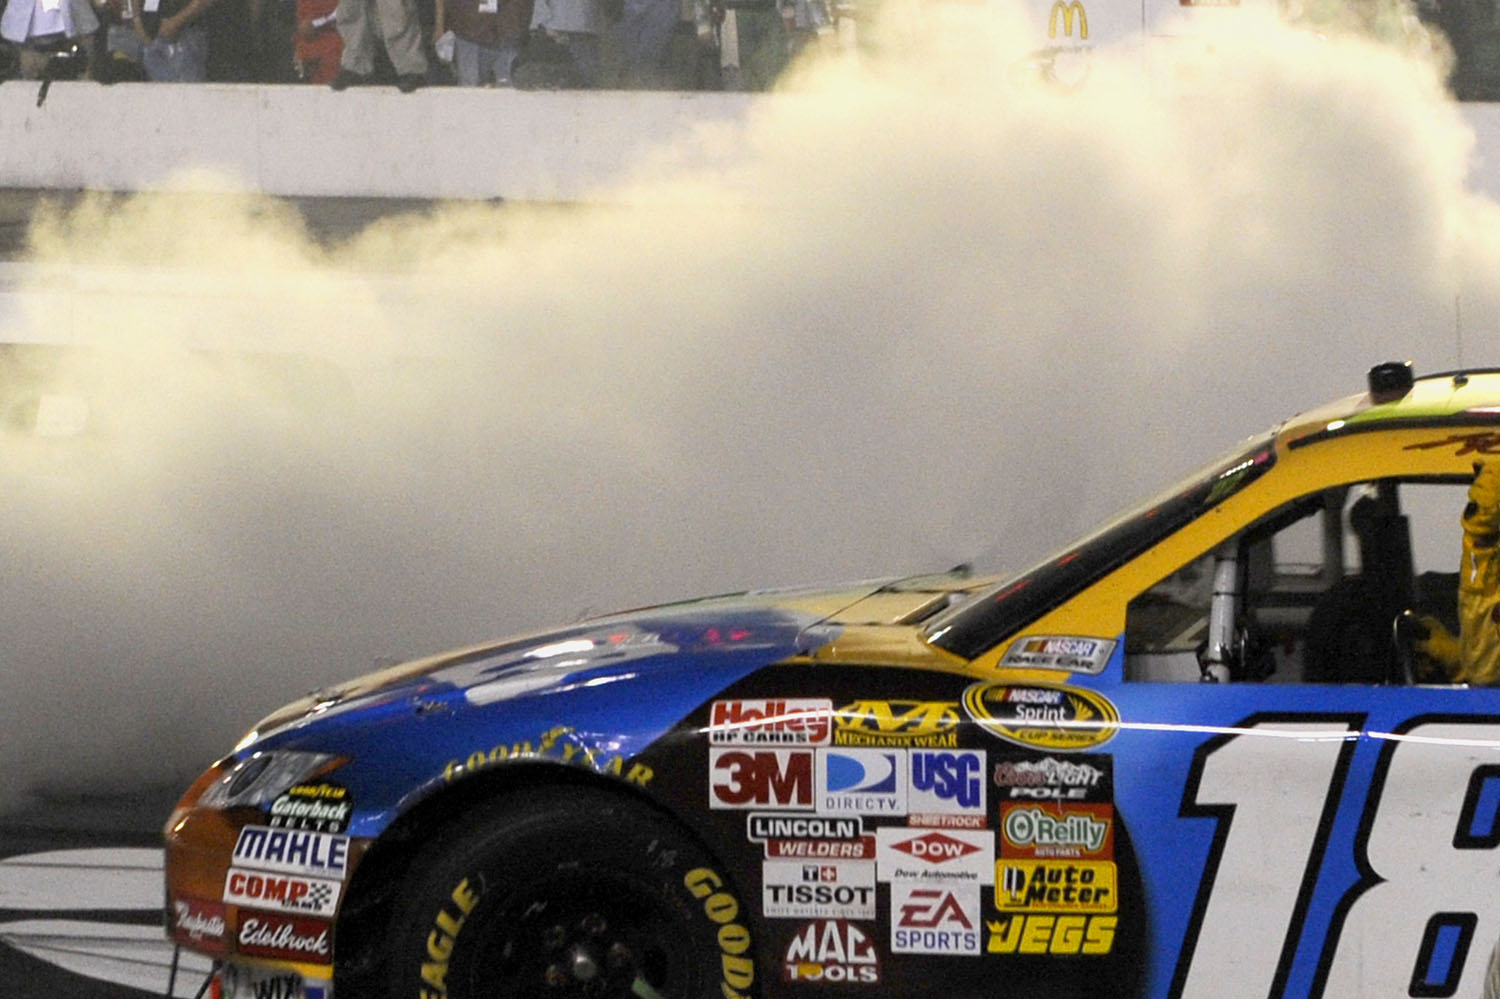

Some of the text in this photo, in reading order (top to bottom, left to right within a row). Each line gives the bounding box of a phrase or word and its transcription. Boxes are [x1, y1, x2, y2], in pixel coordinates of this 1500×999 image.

[1042, 641, 1090, 656] NASCAR
[1008, 688, 1060, 703] NASCAR
[713, 701, 829, 742] Holley
[1015, 704, 1067, 723] Sprint
[835, 730, 957, 747] MECHANIX WEAR
[713, 751, 812, 805] 3M
[912, 752, 980, 808] USG
[826, 798, 897, 810] DIRECTV
[1010, 787, 1087, 799] POLE
[270, 795, 349, 820] Gatorback
[756, 819, 854, 838] LINCOLN
[1006, 809, 1106, 850] O'Reilly
[234, 829, 347, 870] MAHLE
[778, 841, 865, 858] WELDERS
[1033, 866, 1095, 884] Auto
[229, 873, 309, 901] COMP
[766, 885, 873, 905] TISSOT
[1024, 885, 1109, 907] Meter
[899, 889, 973, 930] EA
[239, 918, 329, 955] Edelbrock
[786, 920, 877, 963] MAC
[895, 931, 977, 951] SPORTS
[986, 915, 1118, 954] JEGS
